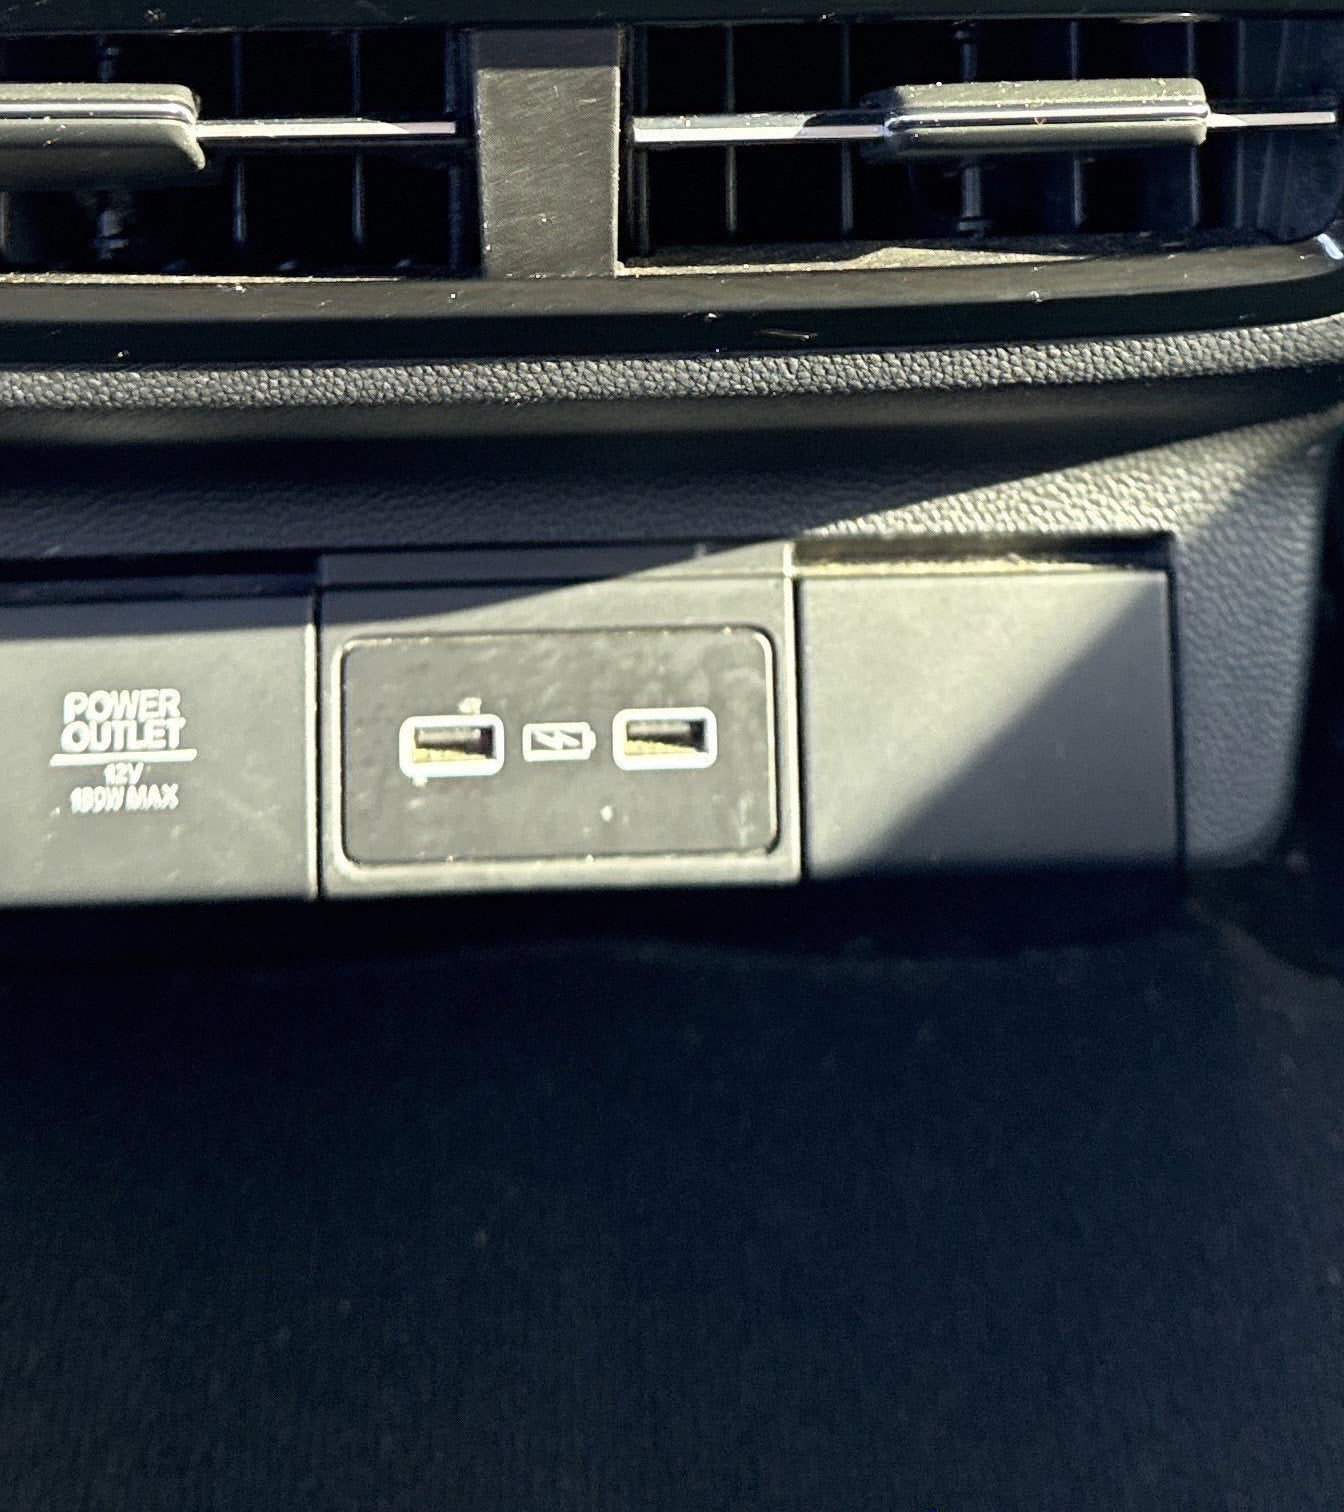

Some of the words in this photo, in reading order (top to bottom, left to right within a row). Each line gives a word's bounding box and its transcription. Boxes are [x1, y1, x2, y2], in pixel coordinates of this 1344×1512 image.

[63, 688, 182, 724] POWER
[60, 717, 187, 753] OUTLET
[104, 761, 145, 785] 12V
[125, 783, 179, 811] MAX
